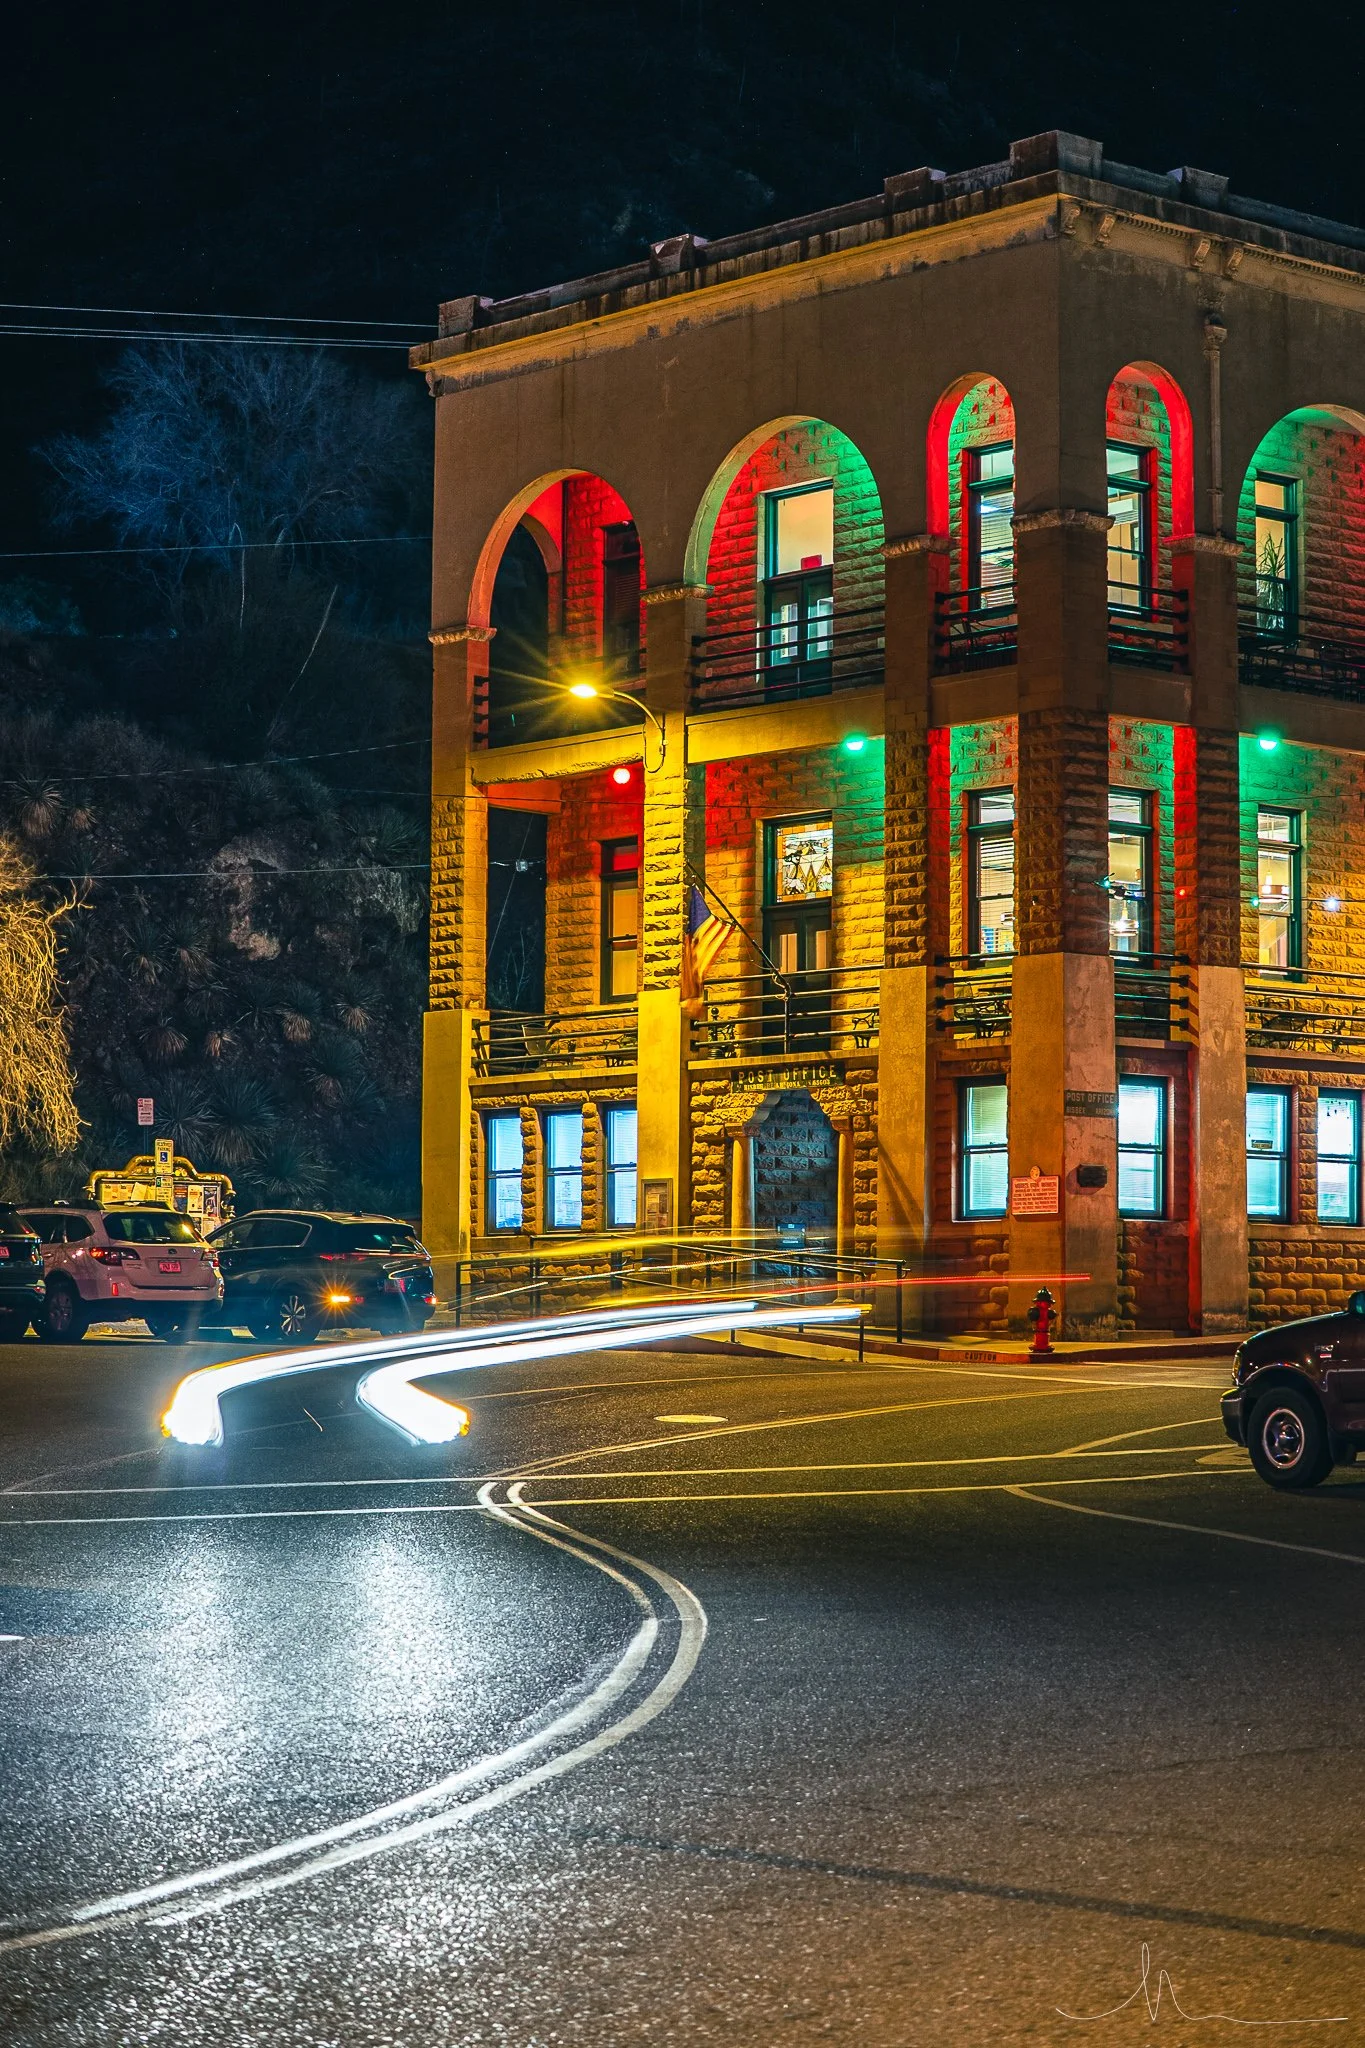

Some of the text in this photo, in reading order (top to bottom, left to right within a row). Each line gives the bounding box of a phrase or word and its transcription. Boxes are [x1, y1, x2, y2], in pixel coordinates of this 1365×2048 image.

[738, 1065, 837, 1083] POST OFFICE
[1066, 1092, 1115, 1104] POST OFFICE
[963, 1352, 996, 1362] CAUTION
